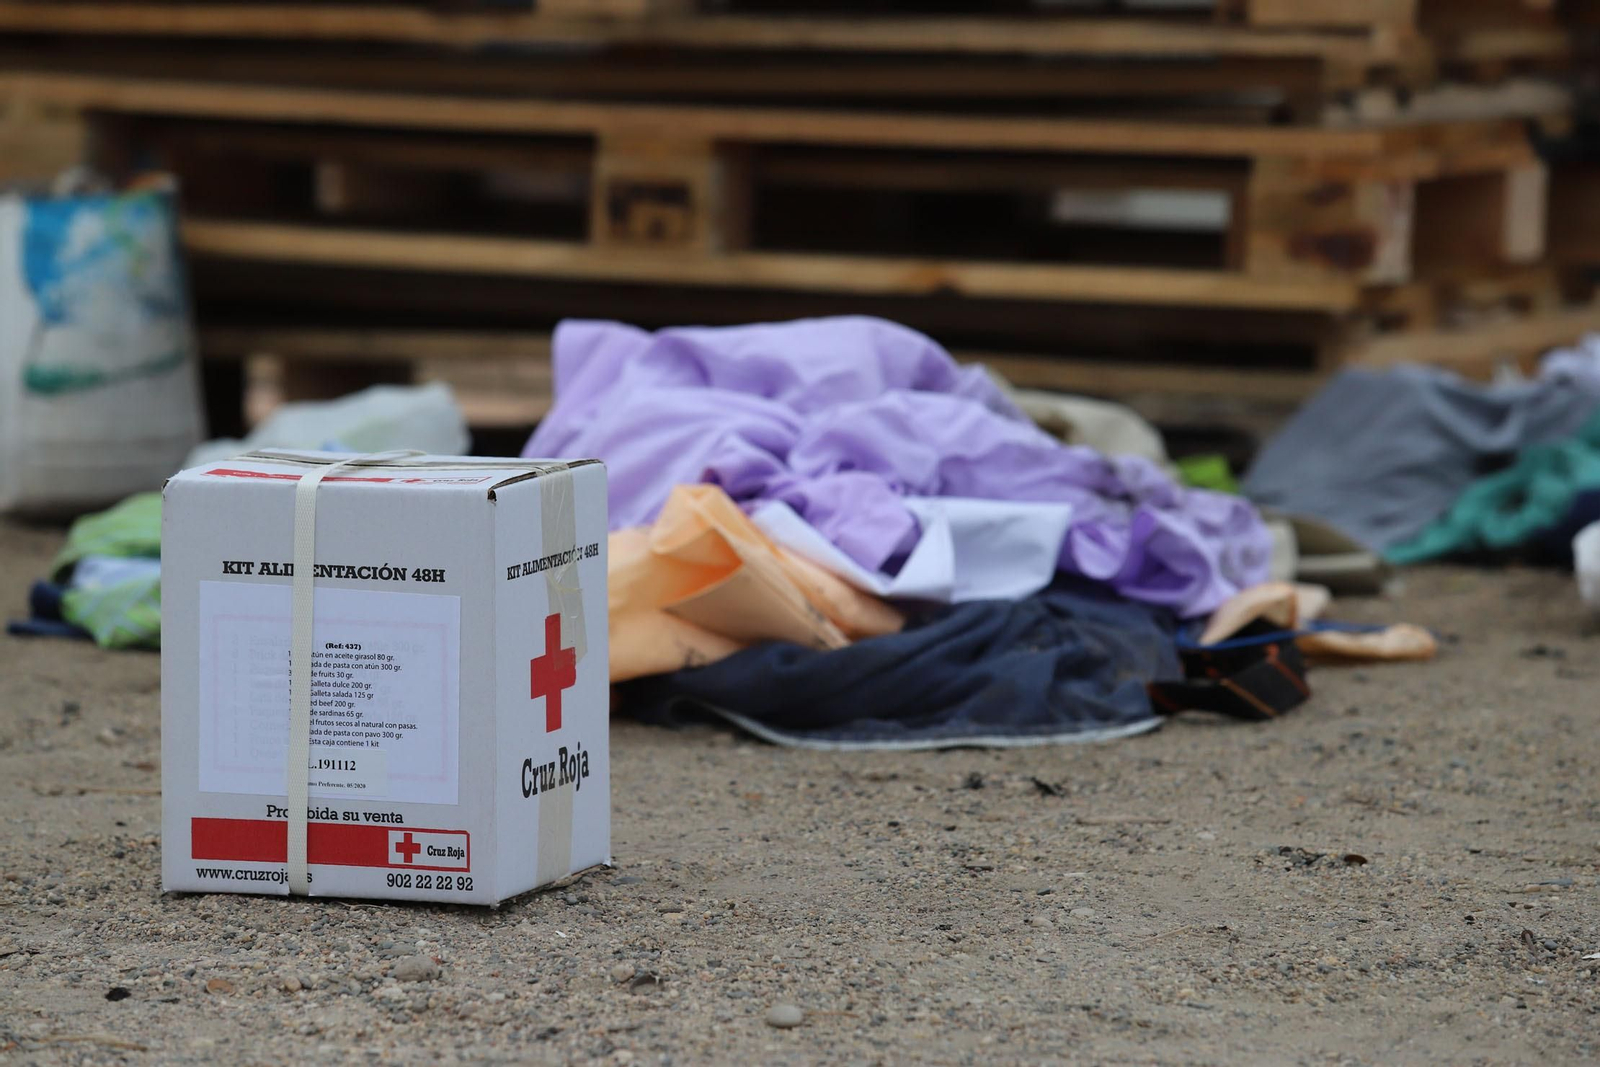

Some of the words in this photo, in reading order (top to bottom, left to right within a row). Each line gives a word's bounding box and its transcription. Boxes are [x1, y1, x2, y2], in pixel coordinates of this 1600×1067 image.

[222, 560, 254, 575] KIT
[258, 562, 407, 581] ALIENTACIÓN
[411, 568, 445, 582] 48H
[507, 564, 521, 580] KIT
[584, 543, 599, 559] 48H
[355, 653, 376, 661] girasol
[322, 739, 335, 747] caja
[336, 739, 365, 747] contiene
[370, 740, 380, 748] kit
[521, 757, 555, 798] Cruz
[558, 741, 589, 792] Roja
[267, 804, 339, 821] Probida
[342, 811, 360, 821] su
[363, 811, 404, 824] venta
[427, 845, 446, 857] Cruz
[447, 846, 465, 860] Roja
[387, 873, 411, 888] 902
[415, 874, 432, 889] 22
[436, 875, 453, 890] 22
[456, 876, 473, 891] 92
